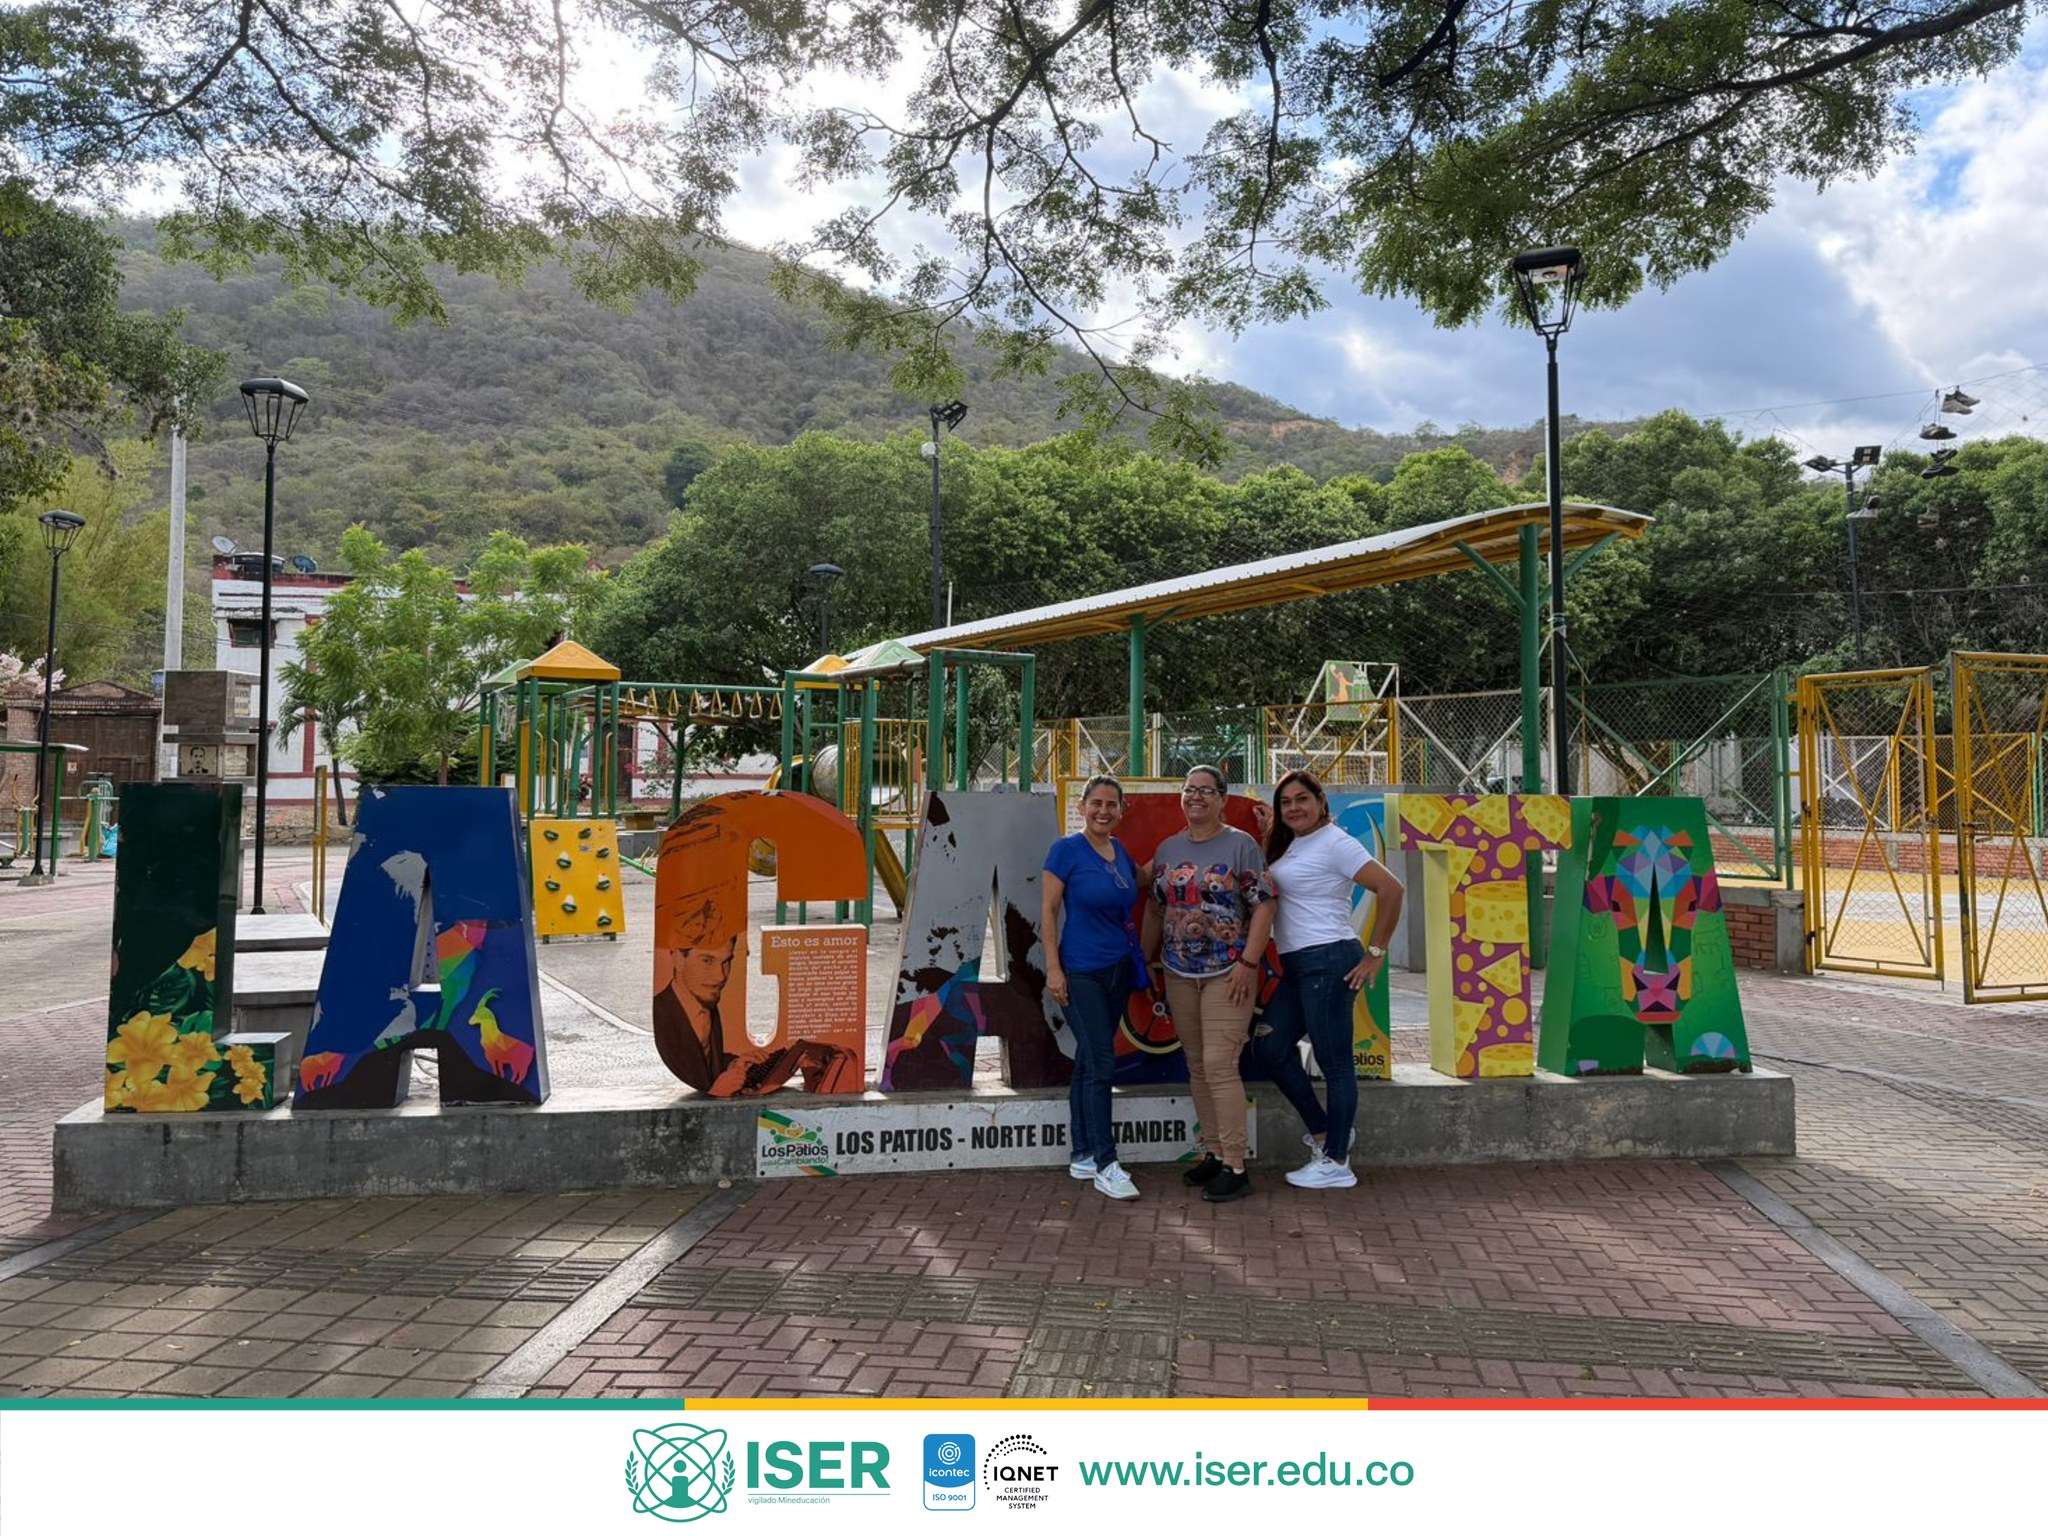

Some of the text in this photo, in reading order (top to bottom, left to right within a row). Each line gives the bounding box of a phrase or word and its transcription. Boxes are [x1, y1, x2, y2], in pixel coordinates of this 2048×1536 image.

[771, 936, 800, 948] Esto
[804, 938, 819, 947] es
[823, 936, 859, 946] amor
[1353, 1051, 1385, 1066] atios
[836, 1131, 874, 1155] LOS
[880, 1127, 952, 1152] PATIOS
[971, 1124, 1036, 1149] NORTE
[1041, 1123, 1066, 1147] DE
[1112, 1118, 1187, 1145] TANDER
